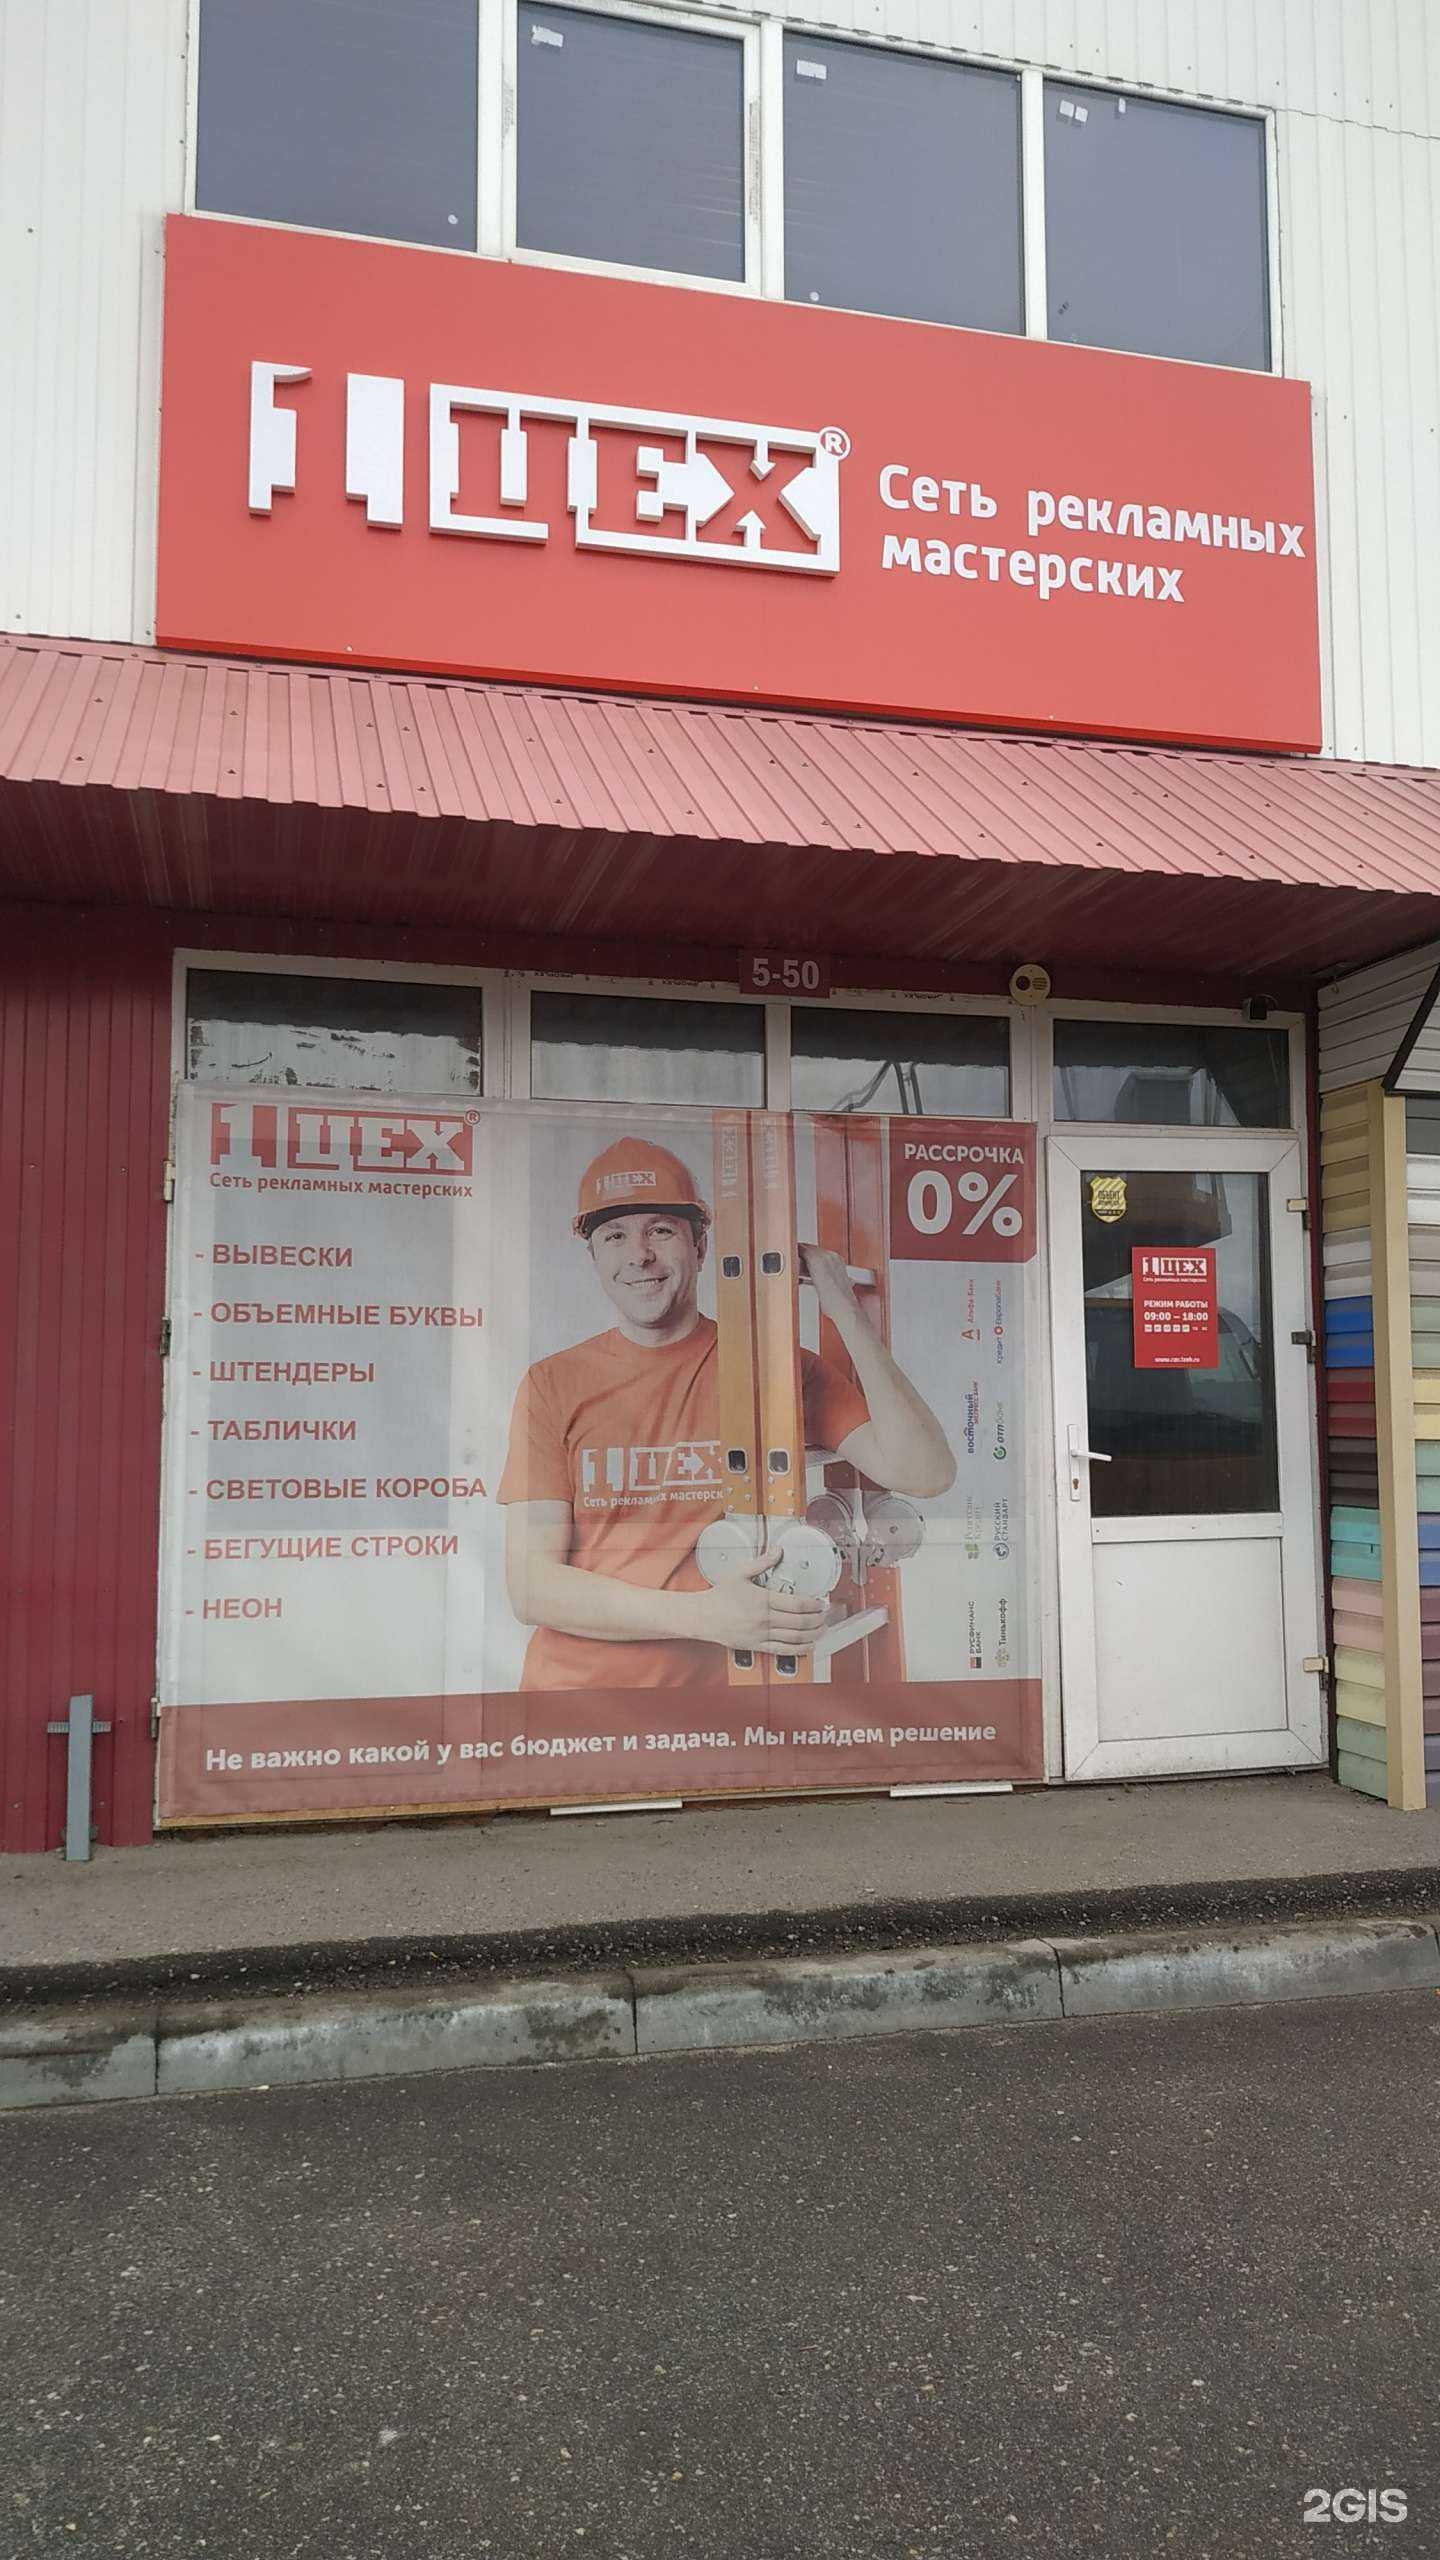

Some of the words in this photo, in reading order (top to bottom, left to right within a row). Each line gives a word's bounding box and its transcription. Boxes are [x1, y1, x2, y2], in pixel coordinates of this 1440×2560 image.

[878, 463, 998, 519] Сеть
[1026, 487, 1307, 558] рекламных
[881, 533, 1185, 603] мастерских
[751, 957, 821, 990] 5-50
[903, 1142, 1025, 1165] РАССРОЧКА
[209, 1171, 253, 1190] Сеть
[257, 1174, 364, 1196] рекламных
[367, 1181, 473, 1199] мастерских
[906, 1168, 1024, 1238] 0%
[212, 1243, 354, 1268] ВЫВЕСКИ
[210, 1302, 381, 1326] ОБЪЕМНЫЕ
[389, 1305, 483, 1328] БУКВЫ
[1143, 1300, 1175, 1308] РЕЖИМ
[1174, 1300, 1209, 1309] РАБОТЫ
[1143, 1312, 1171, 1322] 09:00
[1182, 1312, 1209, 1322] 18:00
[208, 1360, 375, 1386] ШТЕНДЕРЫ
[207, 1419, 357, 1441] ТАБЛИЧКИ
[205, 1477, 367, 1500] СВЕТОВЫЕ
[375, 1476, 488, 1499] КОРОБА
[1001, 1497, 1009, 1542] СТАНДАРТ
[204, 1537, 342, 1562] БЕГУЩИЕ
[350, 1535, 459, 1558] СТРОКИ
[202, 1598, 283, 1620] НЕОН
[998, 1598, 1009, 1646] Тинькофф
[205, 1749, 243, 1772] Не
[250, 1747, 342, 1770] важно
[348, 1740, 430, 1765] какой
[437, 1742, 450, 1766] у
[459, 1739, 504, 1759] вас
[510, 1733, 614, 1757] бюджет
[622, 1736, 638, 1751] и
[644, 1732, 737, 1752] задача.
[744, 1726, 785, 1747] Мы
[792, 1724, 884, 1747] найдем
[889, 1723, 997, 1748] решение
